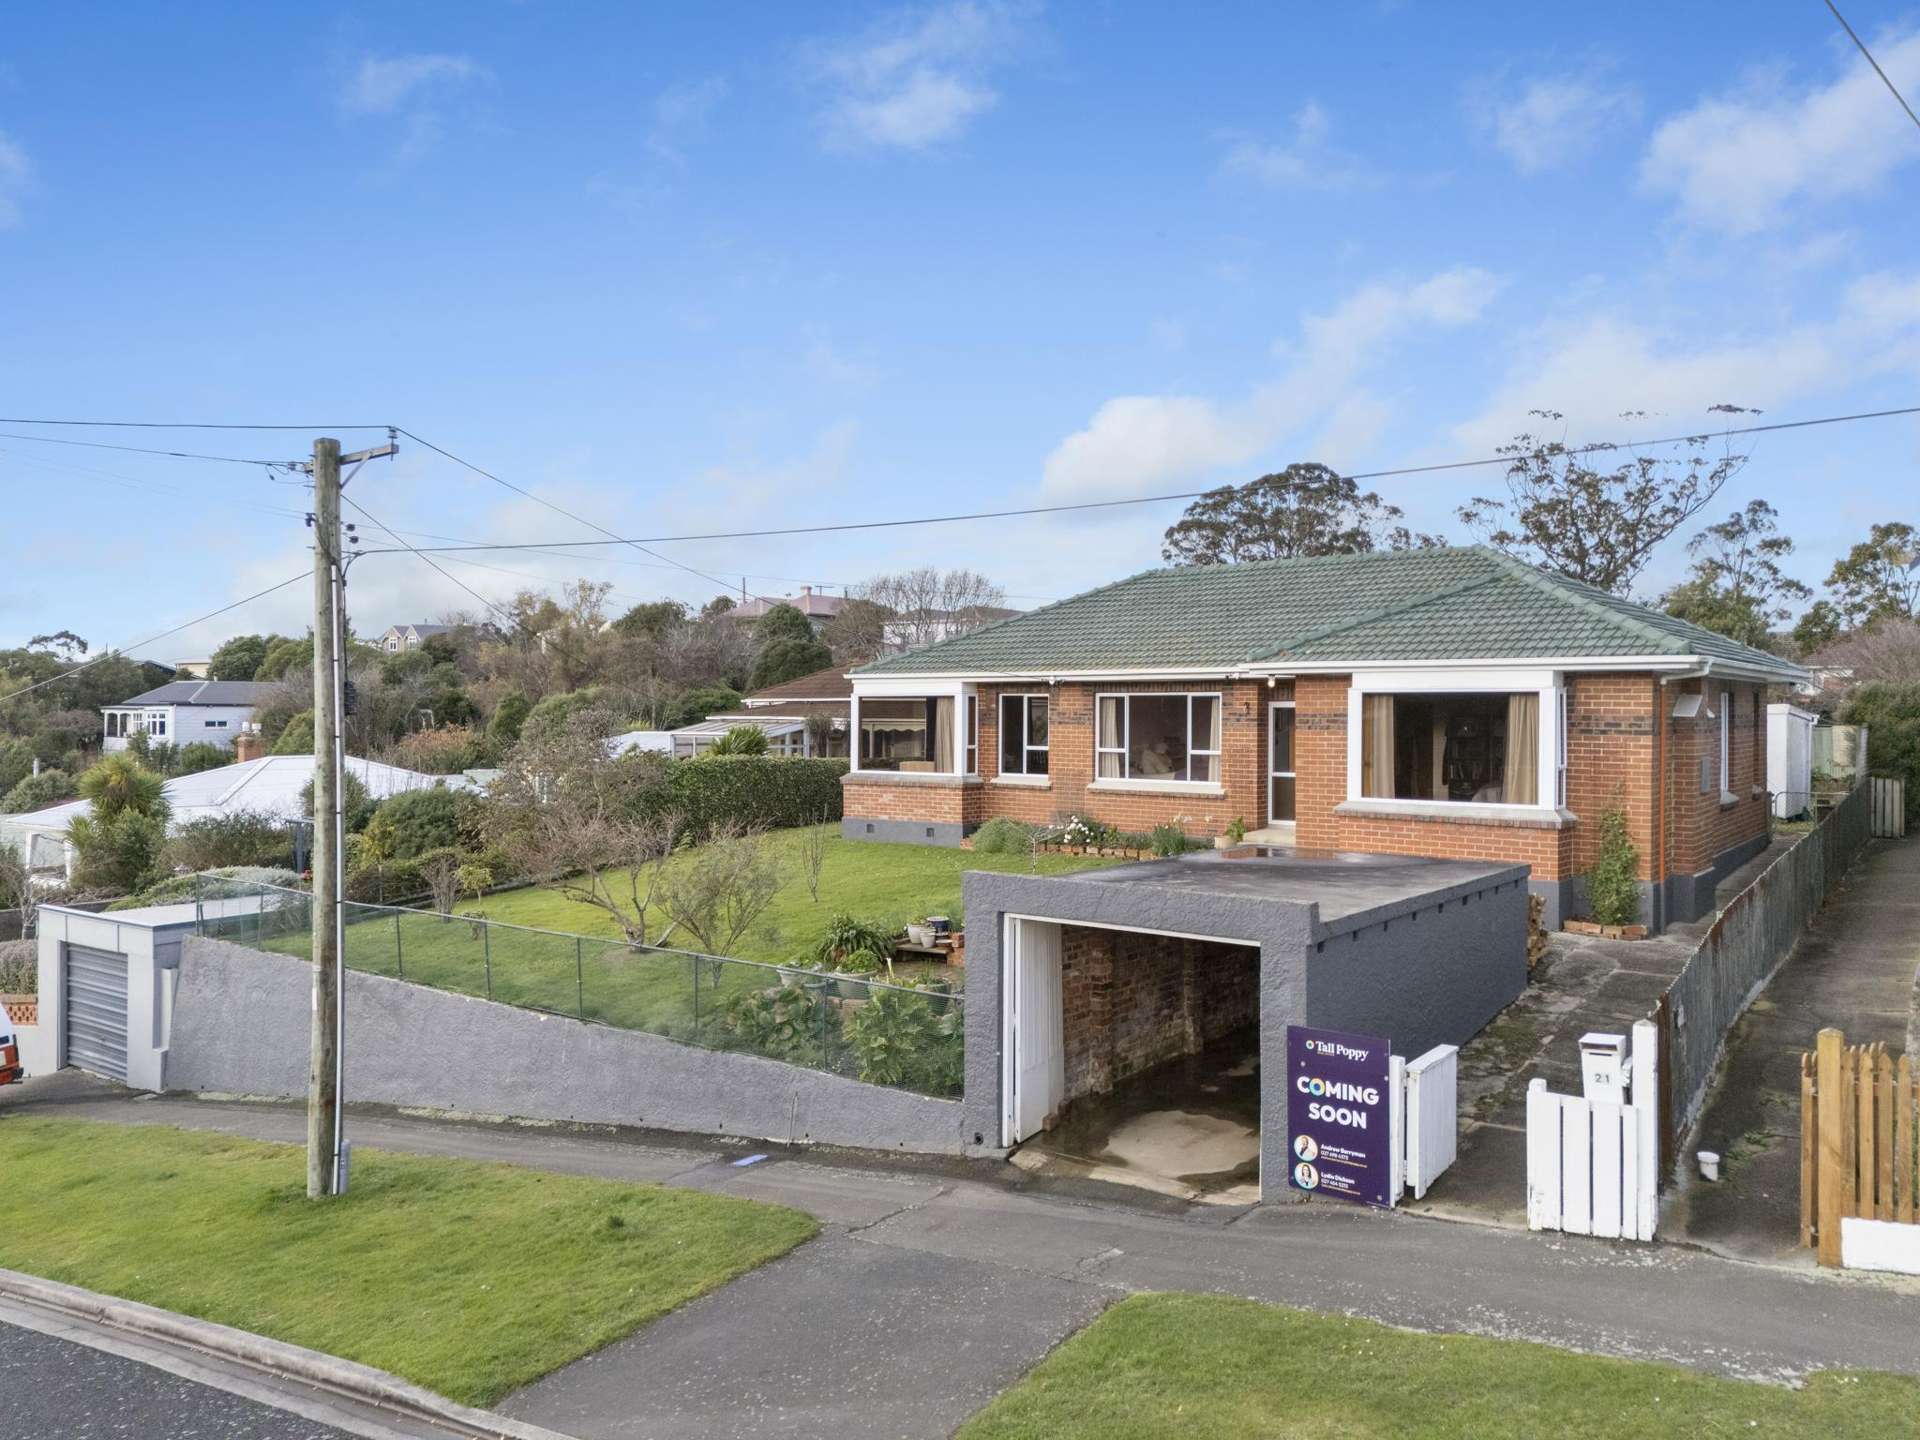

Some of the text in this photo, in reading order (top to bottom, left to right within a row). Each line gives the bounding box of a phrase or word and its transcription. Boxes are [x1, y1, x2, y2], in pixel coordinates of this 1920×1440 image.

[1315, 1041, 1369, 1062] Tall Poppy
[1297, 1076, 1379, 1105] COMING
[1594, 1073, 1610, 1084] 21
[1308, 1102, 1367, 1129] SOON
